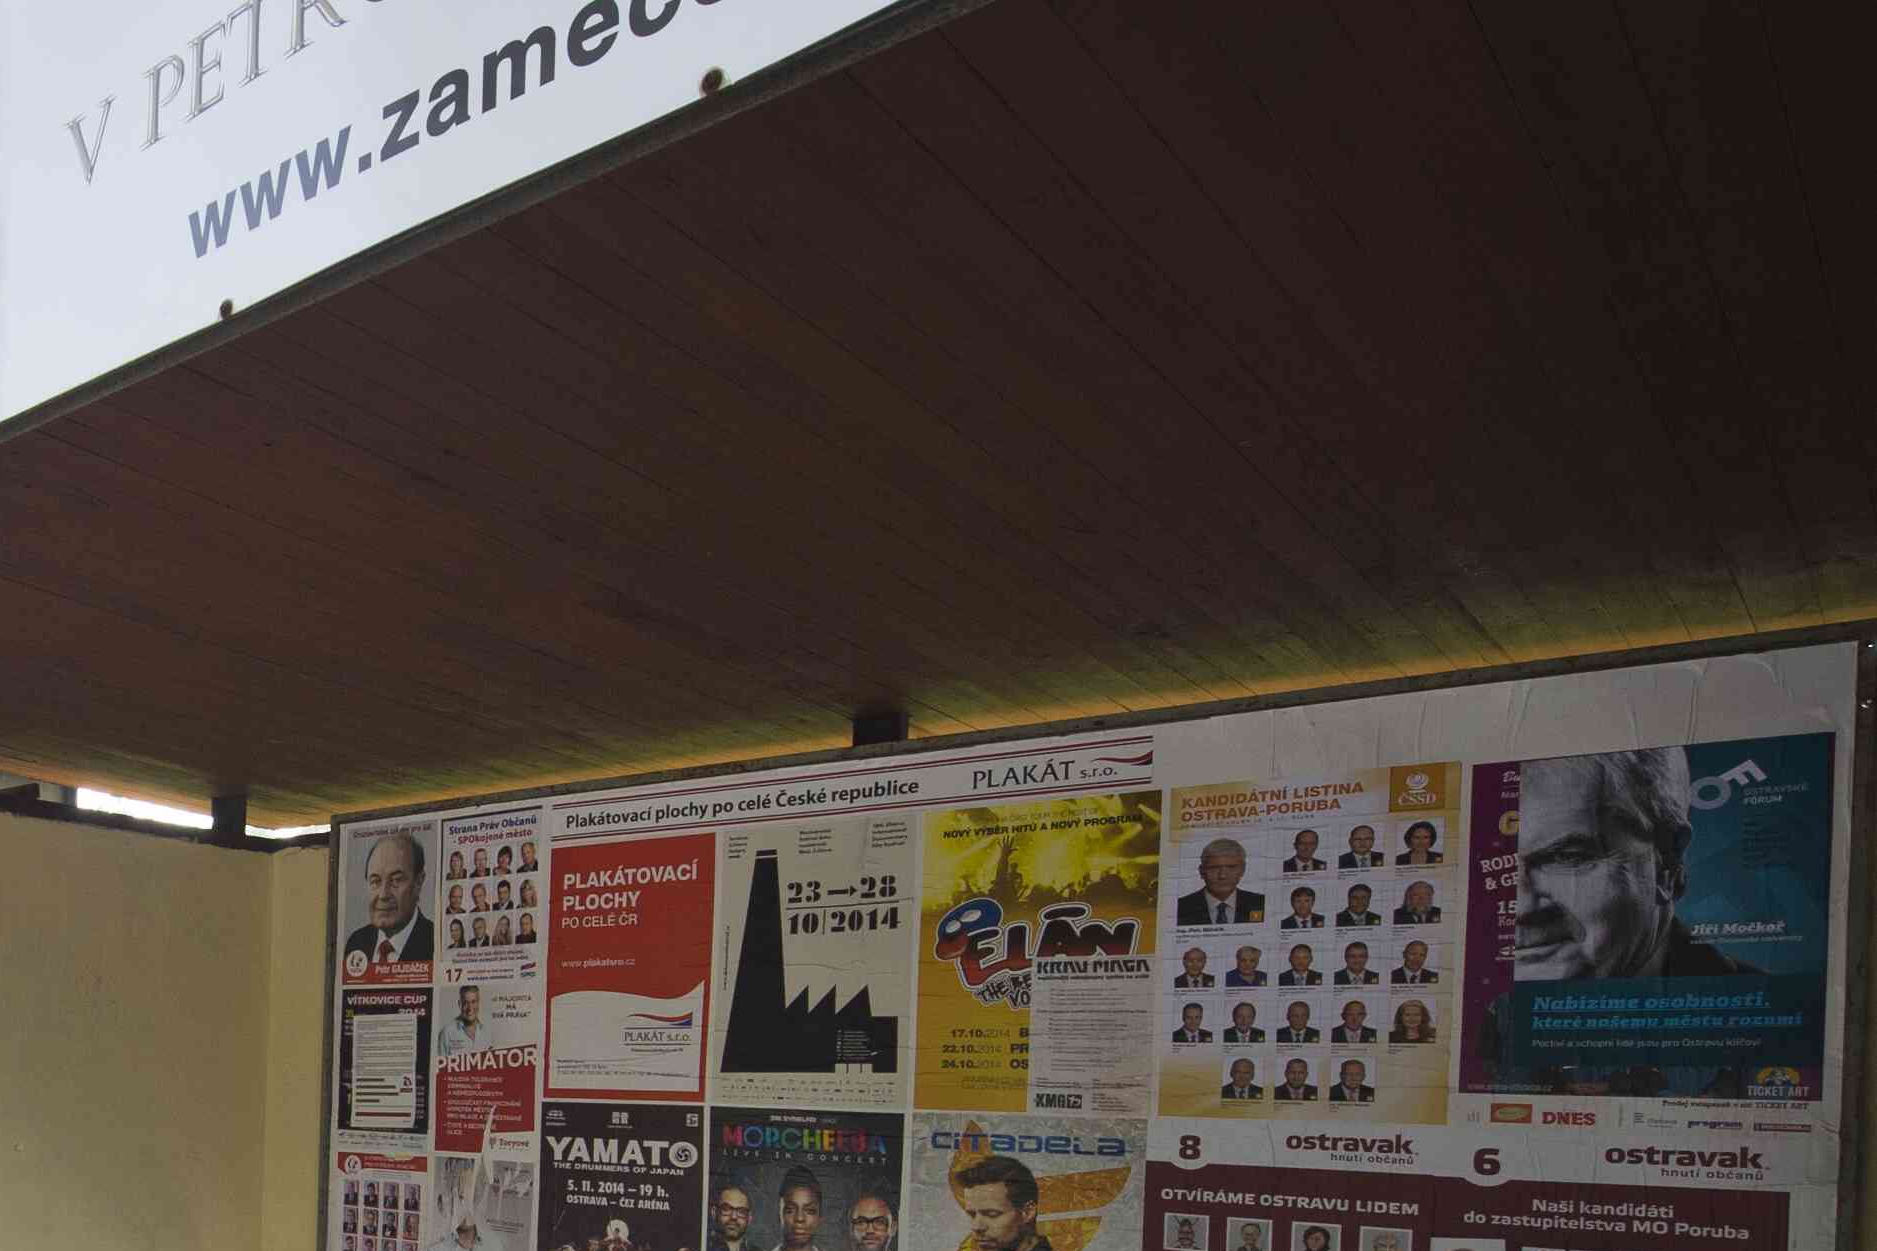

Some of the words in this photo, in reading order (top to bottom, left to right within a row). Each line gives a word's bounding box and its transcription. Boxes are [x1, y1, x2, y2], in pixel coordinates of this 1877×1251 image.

[64, 95, 115, 185] V
[140, 0, 385, 151] PETR
[187, 0, 723, 258] www.zamec
[973, 760, 1076, 790] PLAKÁT
[1079, 767, 1118, 780] s.r.o.
[566, 806, 651, 828] Plakátovací
[655, 802, 708, 823] plochy
[712, 801, 734, 817] po
[737, 795, 771, 811] celé
[776, 784, 827, 808] České
[830, 780, 919, 803] republice
[1182, 787, 1288, 809] KANDIDÁTNÍ
[1292, 781, 1364, 801] LISTINA
[1181, 798, 1341, 823] OSTRAVA-PORUBA
[449, 823, 478, 836] Strana
[943, 828, 972, 839] NOVÝ
[1040, 823, 1048, 831] A
[1050, 818, 1080, 831] NOVÝ
[1083, 814, 1143, 827] PROGRAM
[563, 859, 699, 890] PLAKÁTOVACÍ
[787, 880, 821, 904] 23
[859, 875, 897, 899] 28
[562, 891, 641, 912] PLOCHY
[561, 917, 579, 929] PO
[619, 912, 638, 926] ČR
[788, 911, 819, 936] 10
[830, 906, 899, 932] 2014
[445, 968, 462, 982] 17
[347, 994, 402, 1005] VÍTKOVICE
[404, 995, 427, 1005] CUP
[1532, 995, 1641, 1011] Nabízíme
[1584, 1014, 1660, 1027] našemu
[624, 1030, 665, 1042] PLAKÁT
[435, 1045, 537, 1073] PRIMÁTOR
[1747, 1085, 1784, 1096] TICKET
[1787, 1085, 1811, 1096] ART
[1541, 1111, 1596, 1127] DNES
[545, 1135, 699, 1168] YAMATO
[1179, 1134, 1201, 1160] 8
[1285, 1133, 1413, 1155] ostravak
[553, 1162, 571, 1170] THE
[573, 1163, 630, 1173] DRUMMERS
[649, 1168, 684, 1176] JAPAN
[1330, 1152, 1363, 1163] hnutí
[1367, 1154, 1414, 1166] občanů
[1473, 1148, 1501, 1176] 6
[1605, 1145, 1763, 1170] ostravak
[1660, 1167, 1701, 1180] hnutí
[1706, 1168, 1764, 1182] občanů
[566, 1179, 578, 1191] 5.
[581, 1180, 594, 1192] 11.
[598, 1182, 625, 1195] 2014
[639, 1184, 653, 1196] 19
[656, 1185, 669, 1198] h.
[566, 1194, 608, 1207] OSTRAVA
[637, 1198, 670, 1211] ARÉNA
[1161, 1186, 1255, 1206] OTVÍRÁME
[1259, 1194, 1349, 1212] OSTRAVU
[1355, 1200, 1419, 1216] LIDEM
[1532, 1198, 1574, 1214] Naši
[1579, 1201, 1674, 1218] kandidáti
[1463, 1210, 1486, 1224] do
[1490, 1213, 1626, 1233] zastupitelstva
[1674, 1223, 1749, 1240] Poruba
